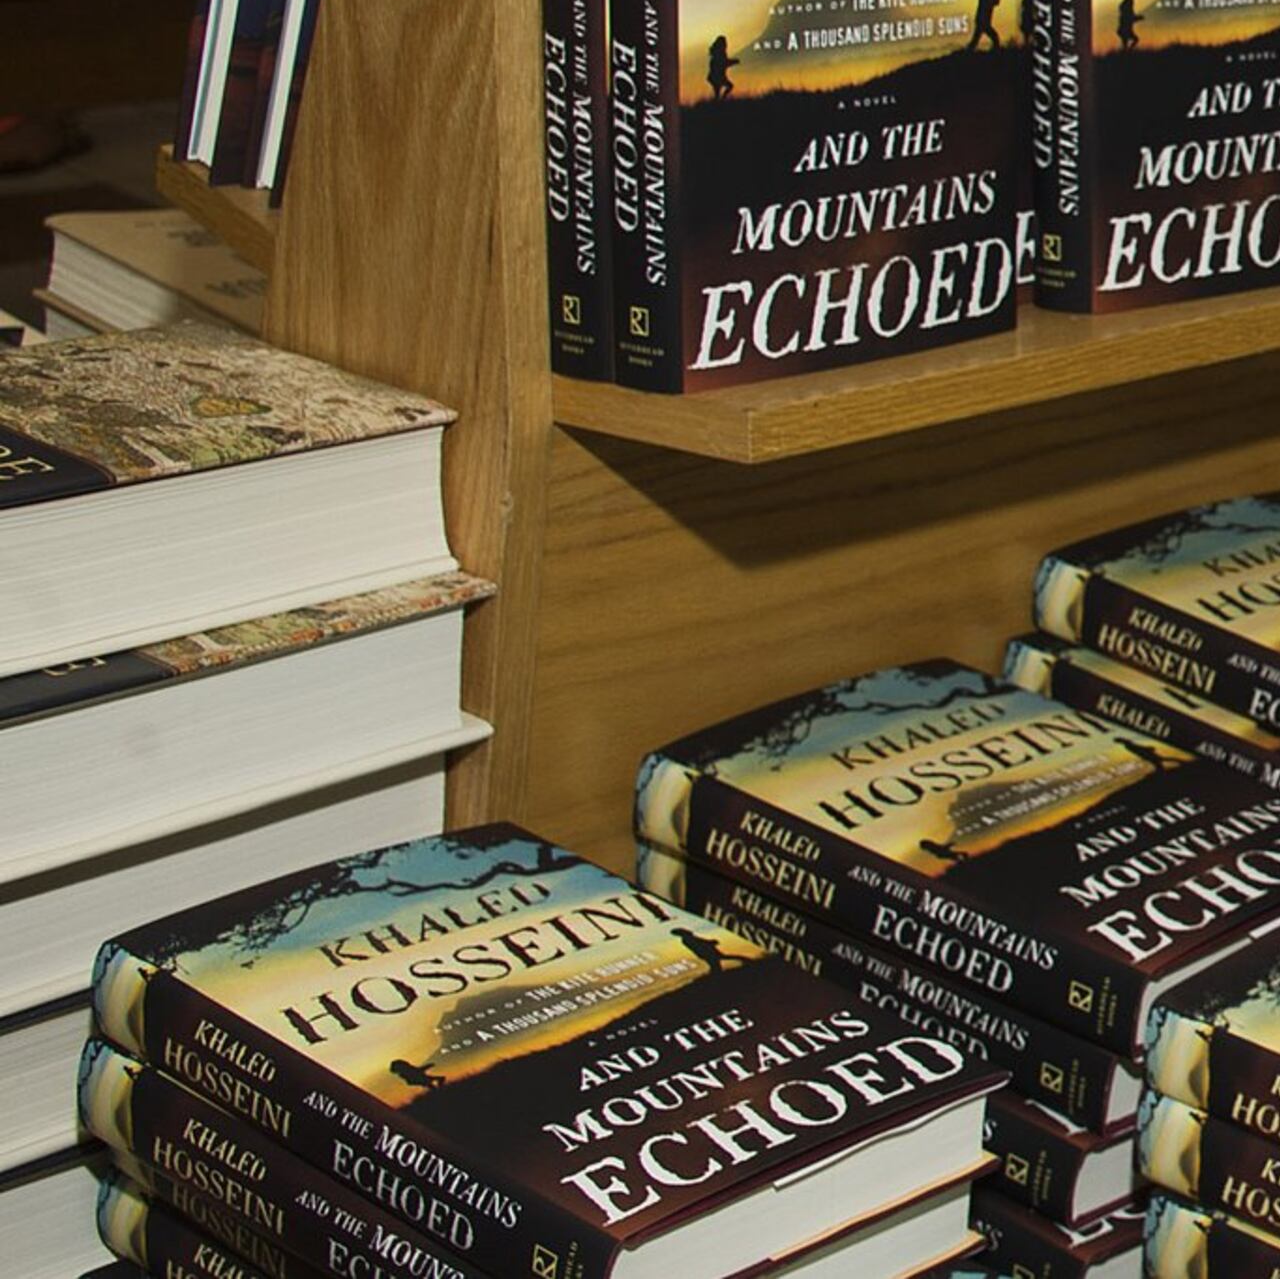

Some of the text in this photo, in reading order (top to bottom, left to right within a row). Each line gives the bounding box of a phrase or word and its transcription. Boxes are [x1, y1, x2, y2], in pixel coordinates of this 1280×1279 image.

[573, 43, 588, 87] THE
[787, 33, 799, 52] A
[802, 25, 872, 48] THOUSAND
[872, 19, 937, 44] SPLENDID
[937, 14, 970, 36] SUNS
[544, 32, 570, 222] ECHOED
[612, 39, 639, 233] ECHOED
[853, 94, 897, 108] NOVEL
[1057, 52, 1080, 217] MOUNTAINS
[1187, 81, 1252, 118] AND
[571, 90, 597, 277] MOUNTAINS
[642, 0, 667, 288] AND THE MOUNTAINS
[793, 117, 946, 175] AND THE
[731, 169, 999, 255] MOUNTAINS
[687, 235, 1015, 371] ECHOED
[1097, 623, 1218, 694] HOSSEINI
[1127, 605, 1204, 651] KHALED
[816, 706, 1110, 830] HOSSEINI
[830, 701, 1007, 772] KHALED
[705, 827, 838, 910] HOSSEINI
[740, 810, 822, 862] KHALED
[1073, 826, 1138, 864] AND
[1138, 796, 1206, 834] THE
[317, 879, 553, 968] KHALED
[848, 864, 1059, 972] AND THE MOUNTAINS
[872, 903, 1015, 994] ECHOED
[280, 891, 672, 1046] HOSSEINI
[477, 1024, 493, 1042] A
[496, 997, 580, 1037] THOUSAND
[578, 972, 654, 1007] SPLENDID
[654, 957, 699, 983] SUNS
[525, 981, 558, 1004] THE
[558, 969, 596, 993] KITE
[596, 951, 655, 981] RUNNER
[899, 969, 1031, 1053] MOUNTAINS
[162, 1036, 293, 1139] HOSSEINI
[192, 1018, 278, 1084] KHALED
[542, 1010, 870, 1153] MOUNTAINS
[578, 1008, 755, 1092] AND THE
[182, 1117, 268, 1183] KHALED
[560, 1035, 965, 1227] ECHOED
[152, 1135, 286, 1237] HOSSEINI
[332, 1137, 476, 1253] ECHOED
[373, 1124, 523, 1231] MOUNTAINS
